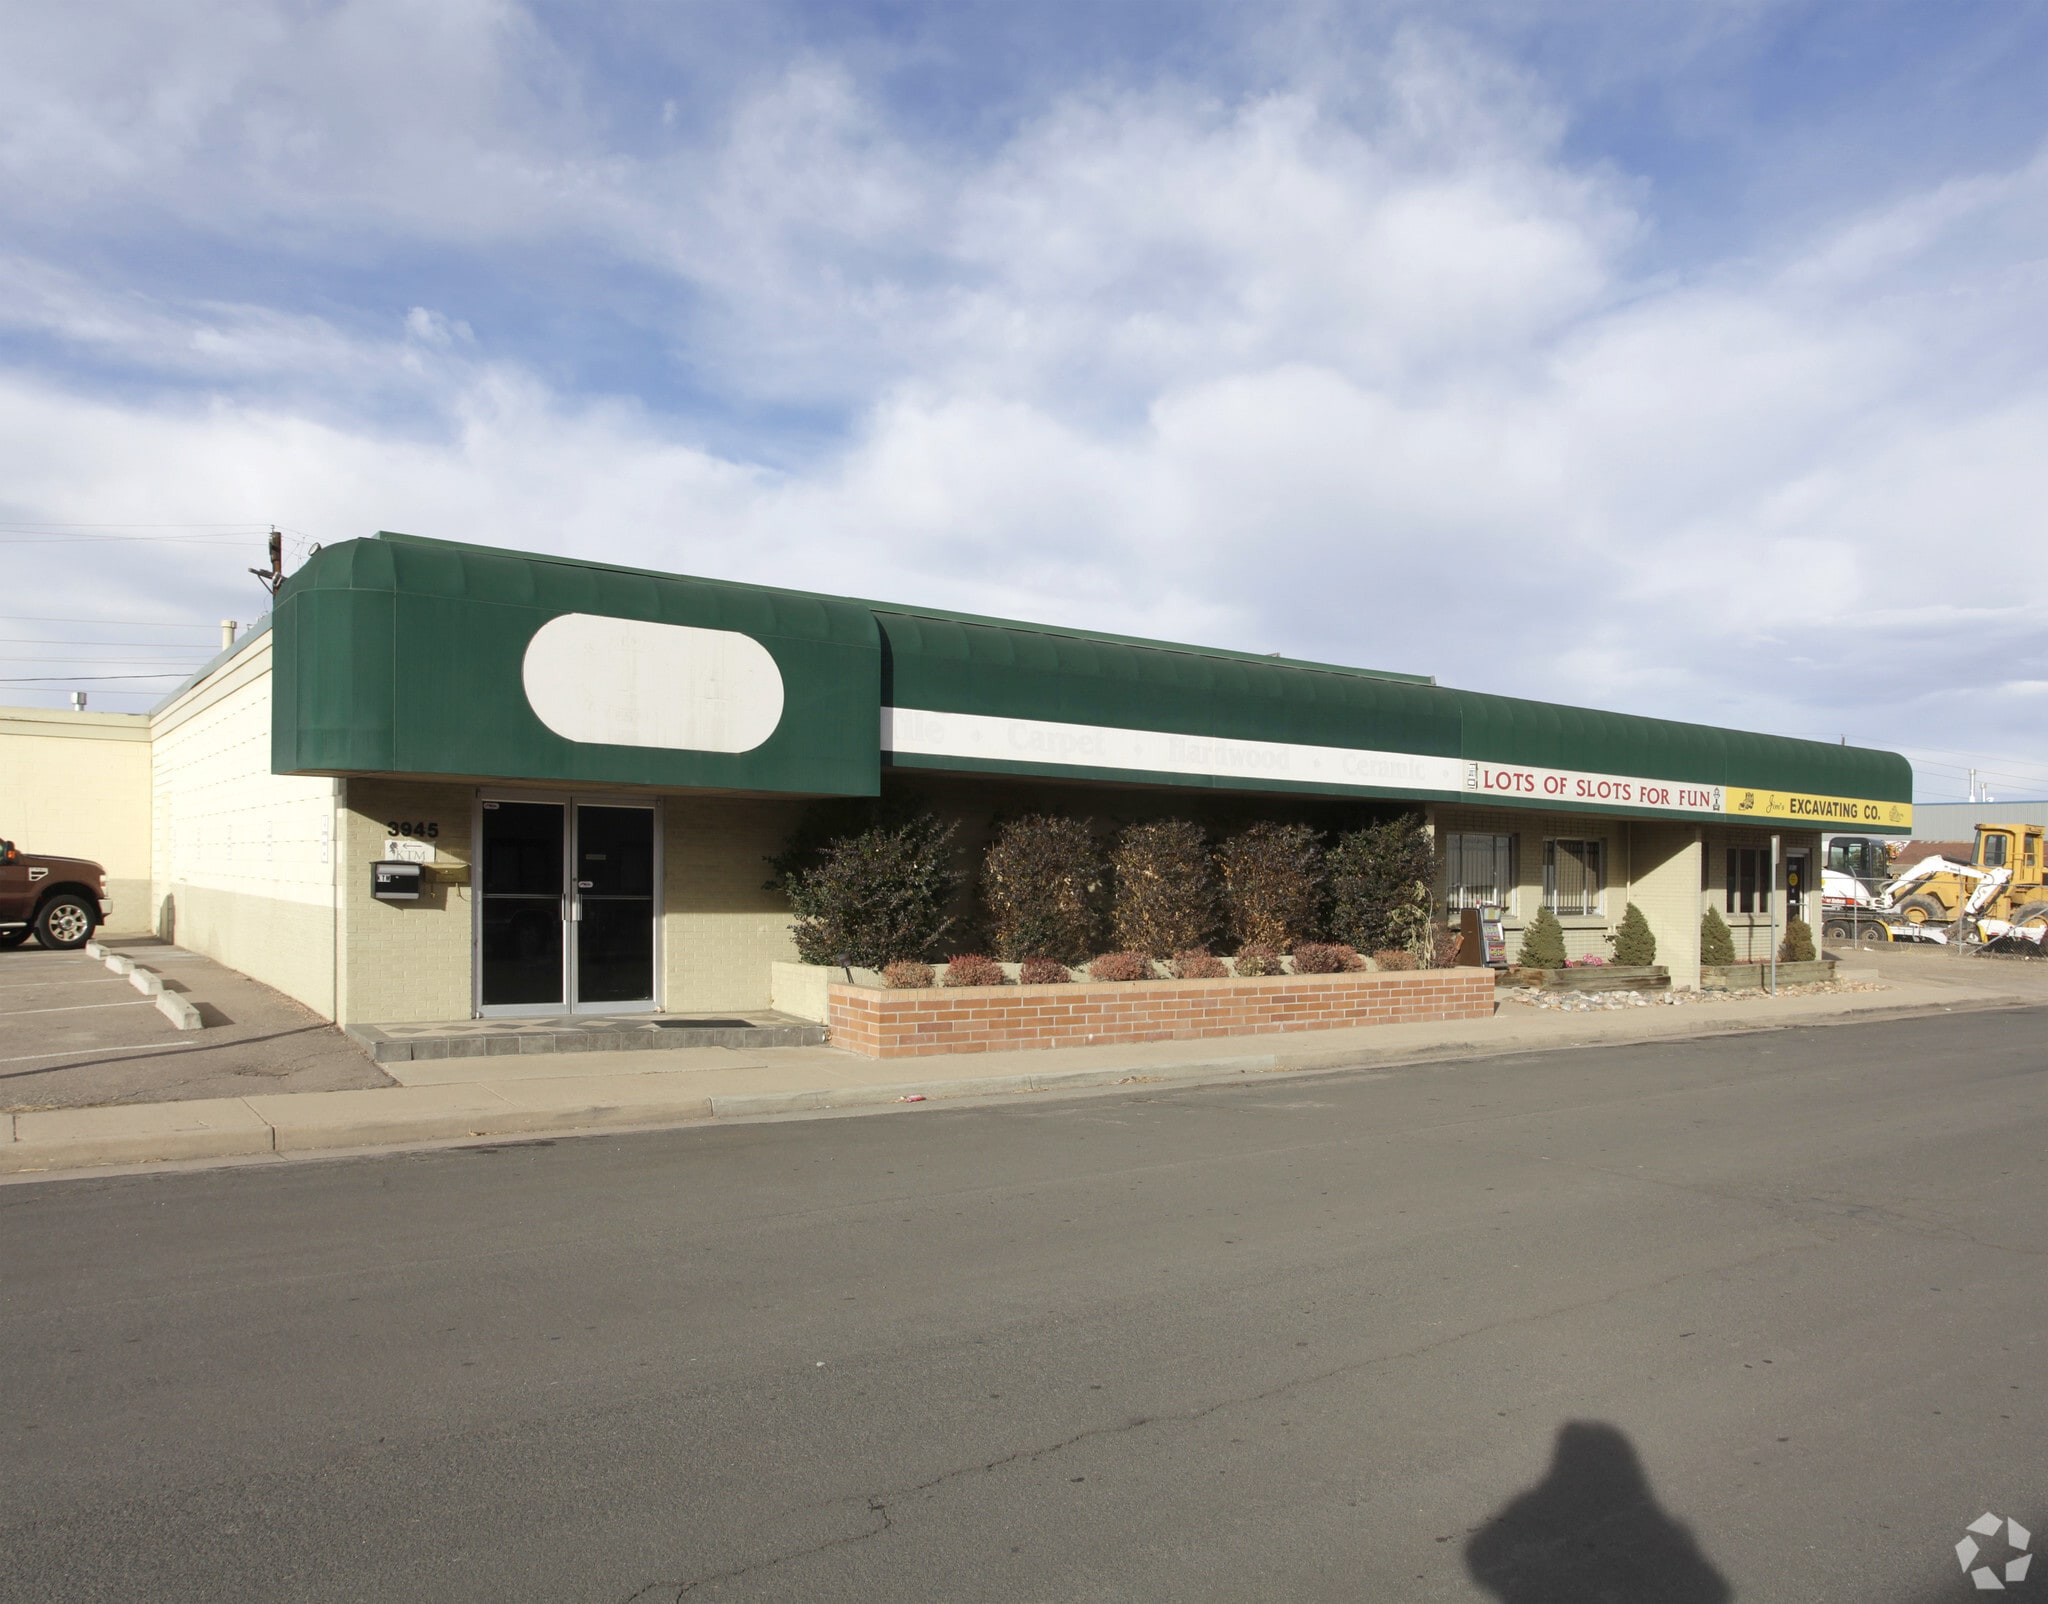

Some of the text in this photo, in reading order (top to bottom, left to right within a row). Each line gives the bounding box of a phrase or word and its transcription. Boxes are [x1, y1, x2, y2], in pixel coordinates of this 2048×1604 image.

[1007, 722, 1107, 761] Carpet
[1167, 737, 1291, 770] Hardwood
[1342, 753, 1426, 781] Ceramic
[1483, 769, 1711, 807] LOTS OF SLOTS FOR FUN
[1766, 794, 1881, 820] Jim's EXCAVATING CO.
[387, 821, 439, 838] 3945
[396, 850, 426, 861] KTM
